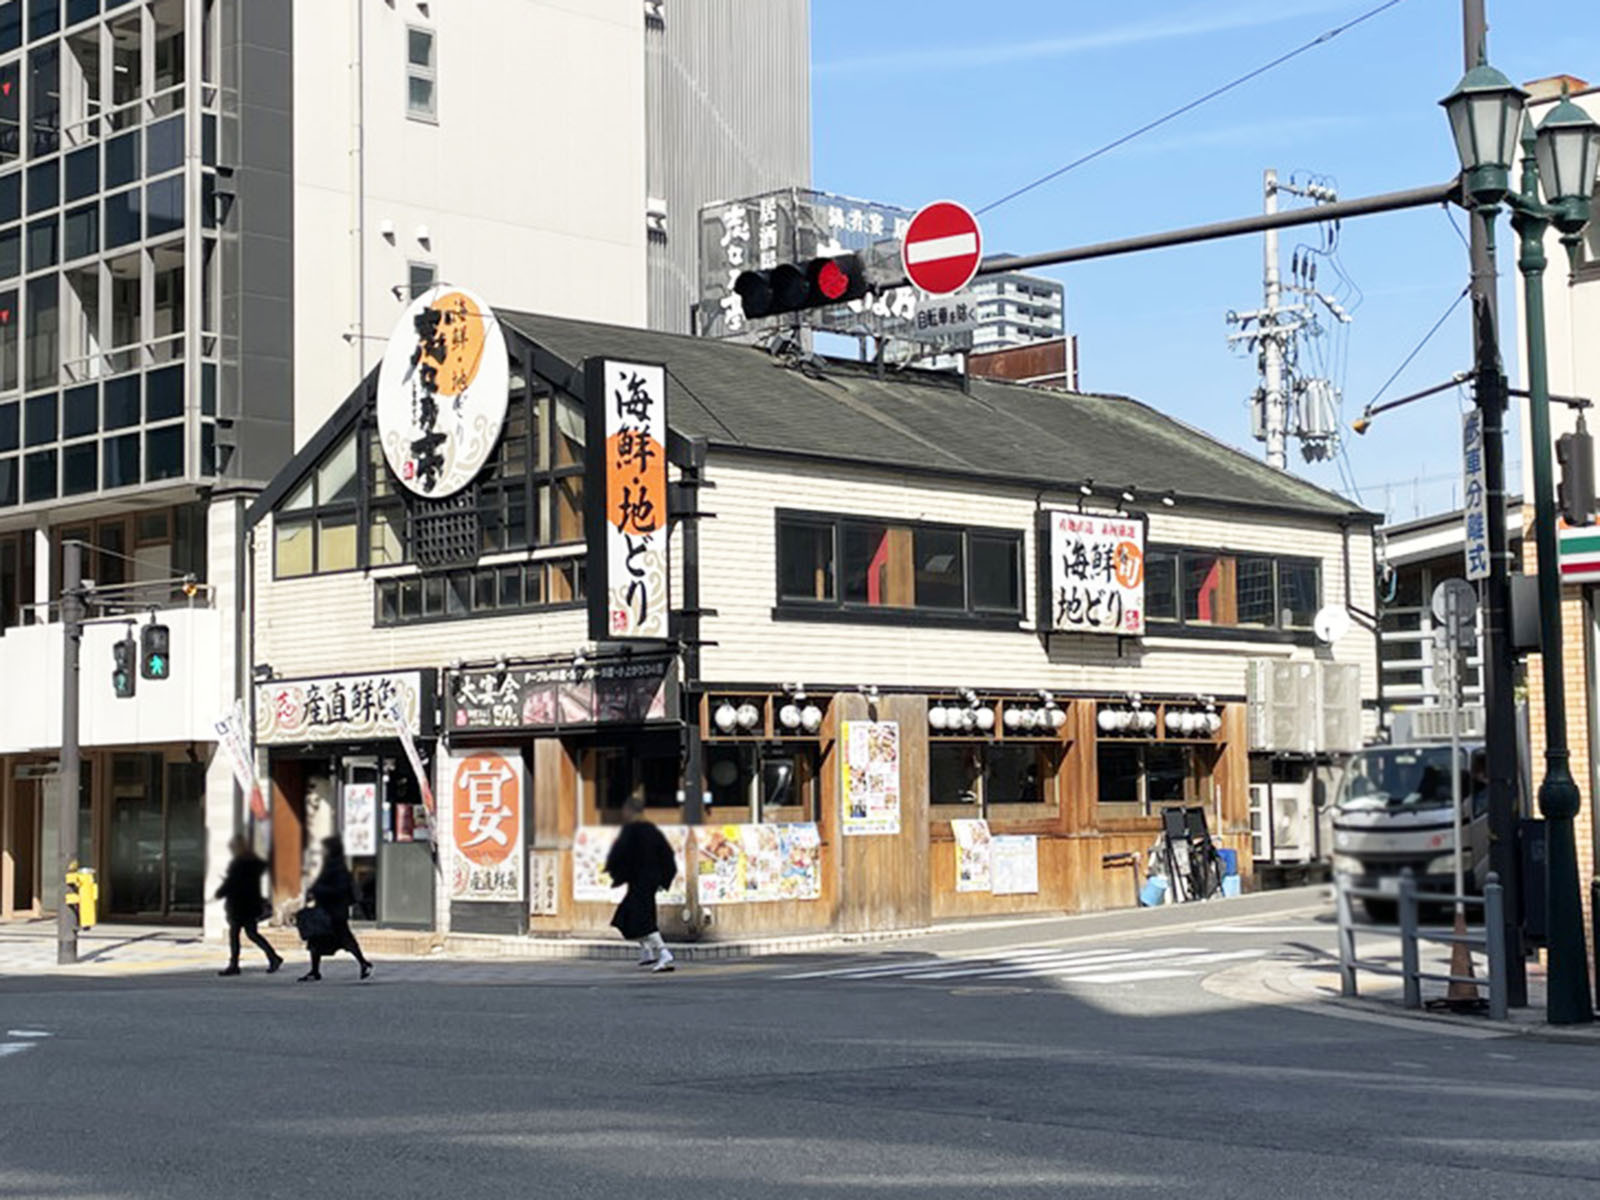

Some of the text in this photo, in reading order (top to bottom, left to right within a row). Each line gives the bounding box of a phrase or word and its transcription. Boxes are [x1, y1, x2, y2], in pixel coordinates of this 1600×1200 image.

[917, 303, 975, 330] 自転車を除く
[615, 371, 655, 626] 海鮮・地どり
[1063, 539, 1117, 583] 海鮮
[1056, 586, 1122, 629] 地どり
[457, 672, 521, 705] 大宴会
[458, 761, 515, 847] 宴
